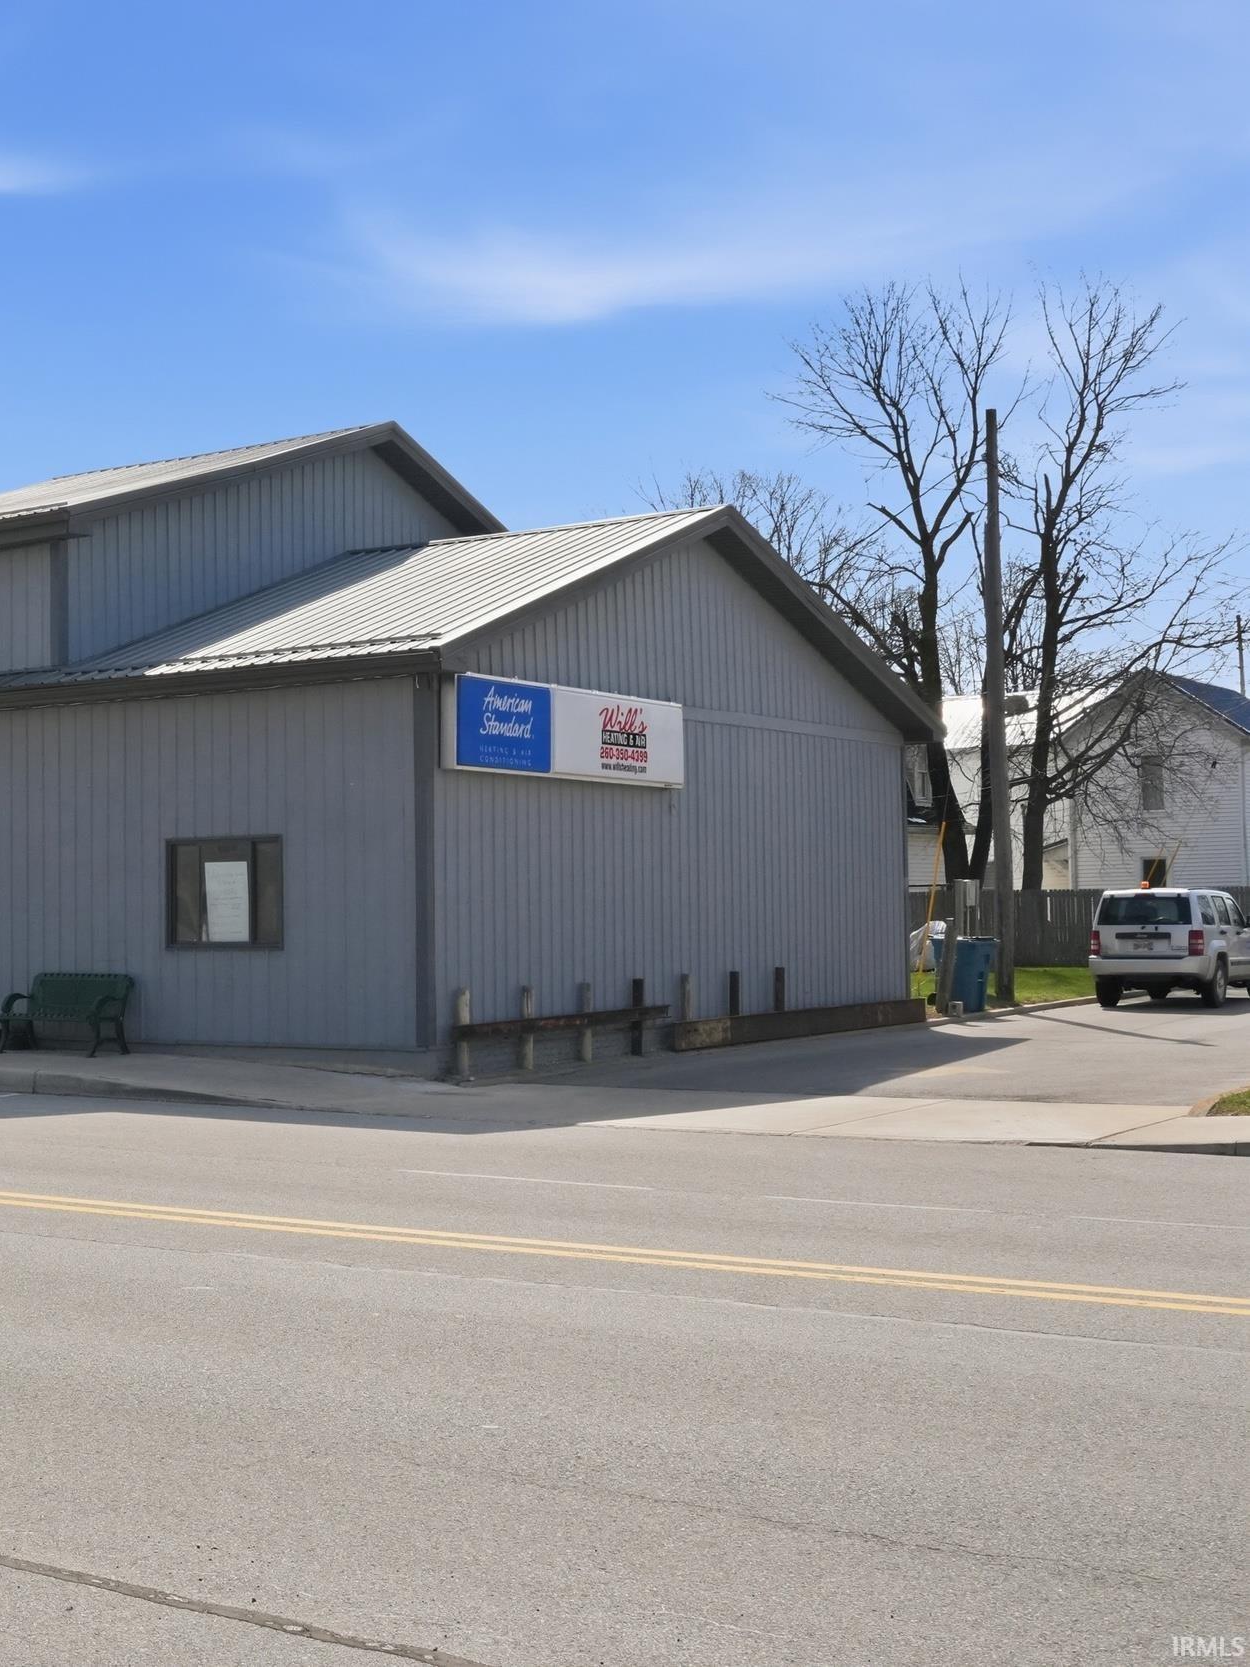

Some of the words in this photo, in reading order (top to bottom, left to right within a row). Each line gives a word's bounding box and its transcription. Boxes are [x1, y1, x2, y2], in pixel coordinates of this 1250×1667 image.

[483, 686, 532, 715] American
[480, 712, 533, 738] Standard
[599, 705, 647, 734] Will's
[603, 731, 628, 745] HEATING
[635, 734, 646, 748] AIR
[600, 746, 648, 763] 260-350-4399
